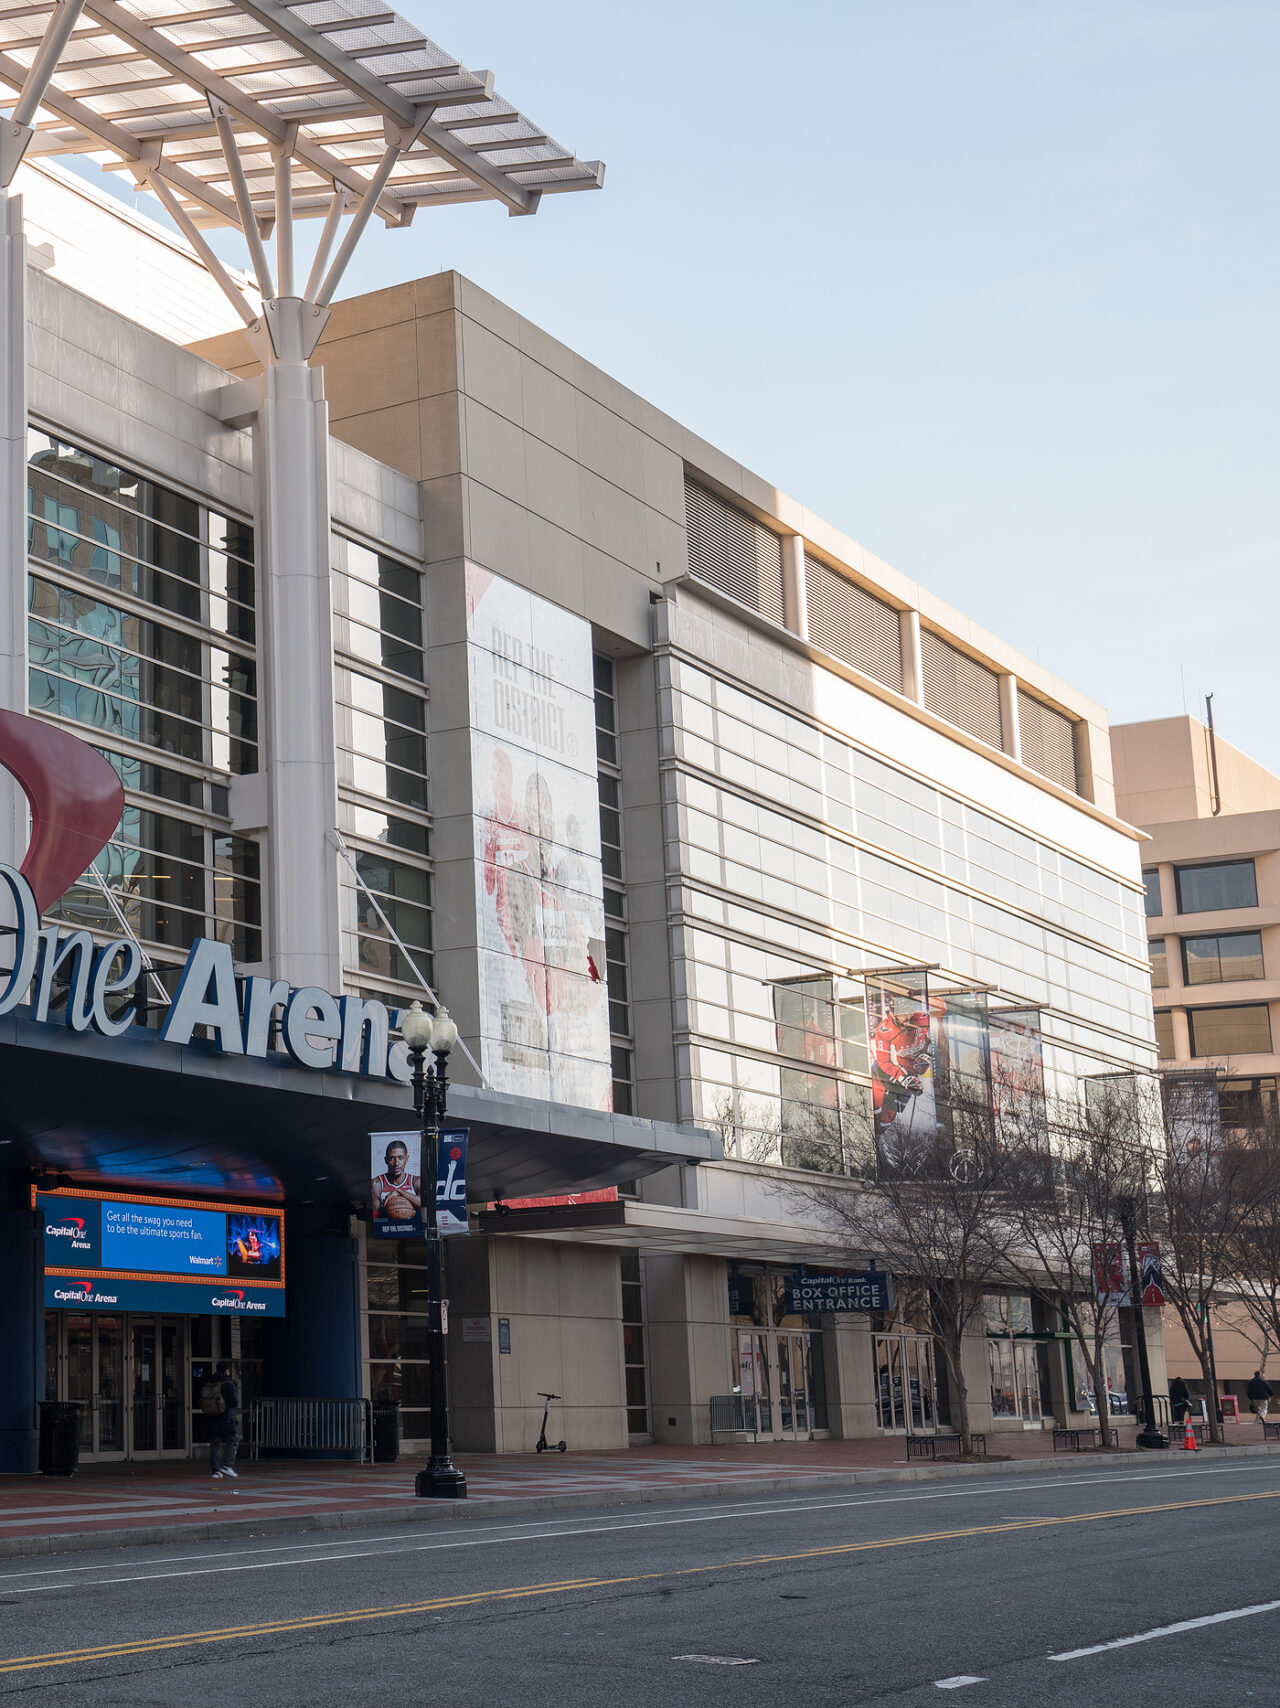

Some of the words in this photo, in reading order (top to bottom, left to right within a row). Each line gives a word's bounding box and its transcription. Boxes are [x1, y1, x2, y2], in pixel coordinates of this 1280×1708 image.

[491, 625, 523, 678] REP
[526, 644, 557, 699] THE
[493, 679, 566, 754] DISTRICT
[106, 1210, 121, 1222] Get
[121, 1213, 130, 1222] all
[131, 1214, 143, 1224] the
[144, 1216, 161, 1227] swag
[162, 1218, 175, 1228] you
[176, 1218, 193, 1228] need
[107, 1224, 114, 1233] to
[116, 1224, 125, 1234] be
[126, 1225, 138, 1235] the
[140, 1226, 168, 1238] ultimate
[169, 1230, 190, 1240] sports
[191, 1230, 203, 1240] fan.
[71, 1240, 91, 1249] Arena
[189, 1255, 214, 1265] Walmart
[94, 1293, 118, 1303] Arena
[792, 1287, 823, 1299] BOX
[827, 1284, 880, 1297] OFFICE
[246, 1300, 266, 1310] Arena
[793, 1296, 881, 1311] ENTRANCE
